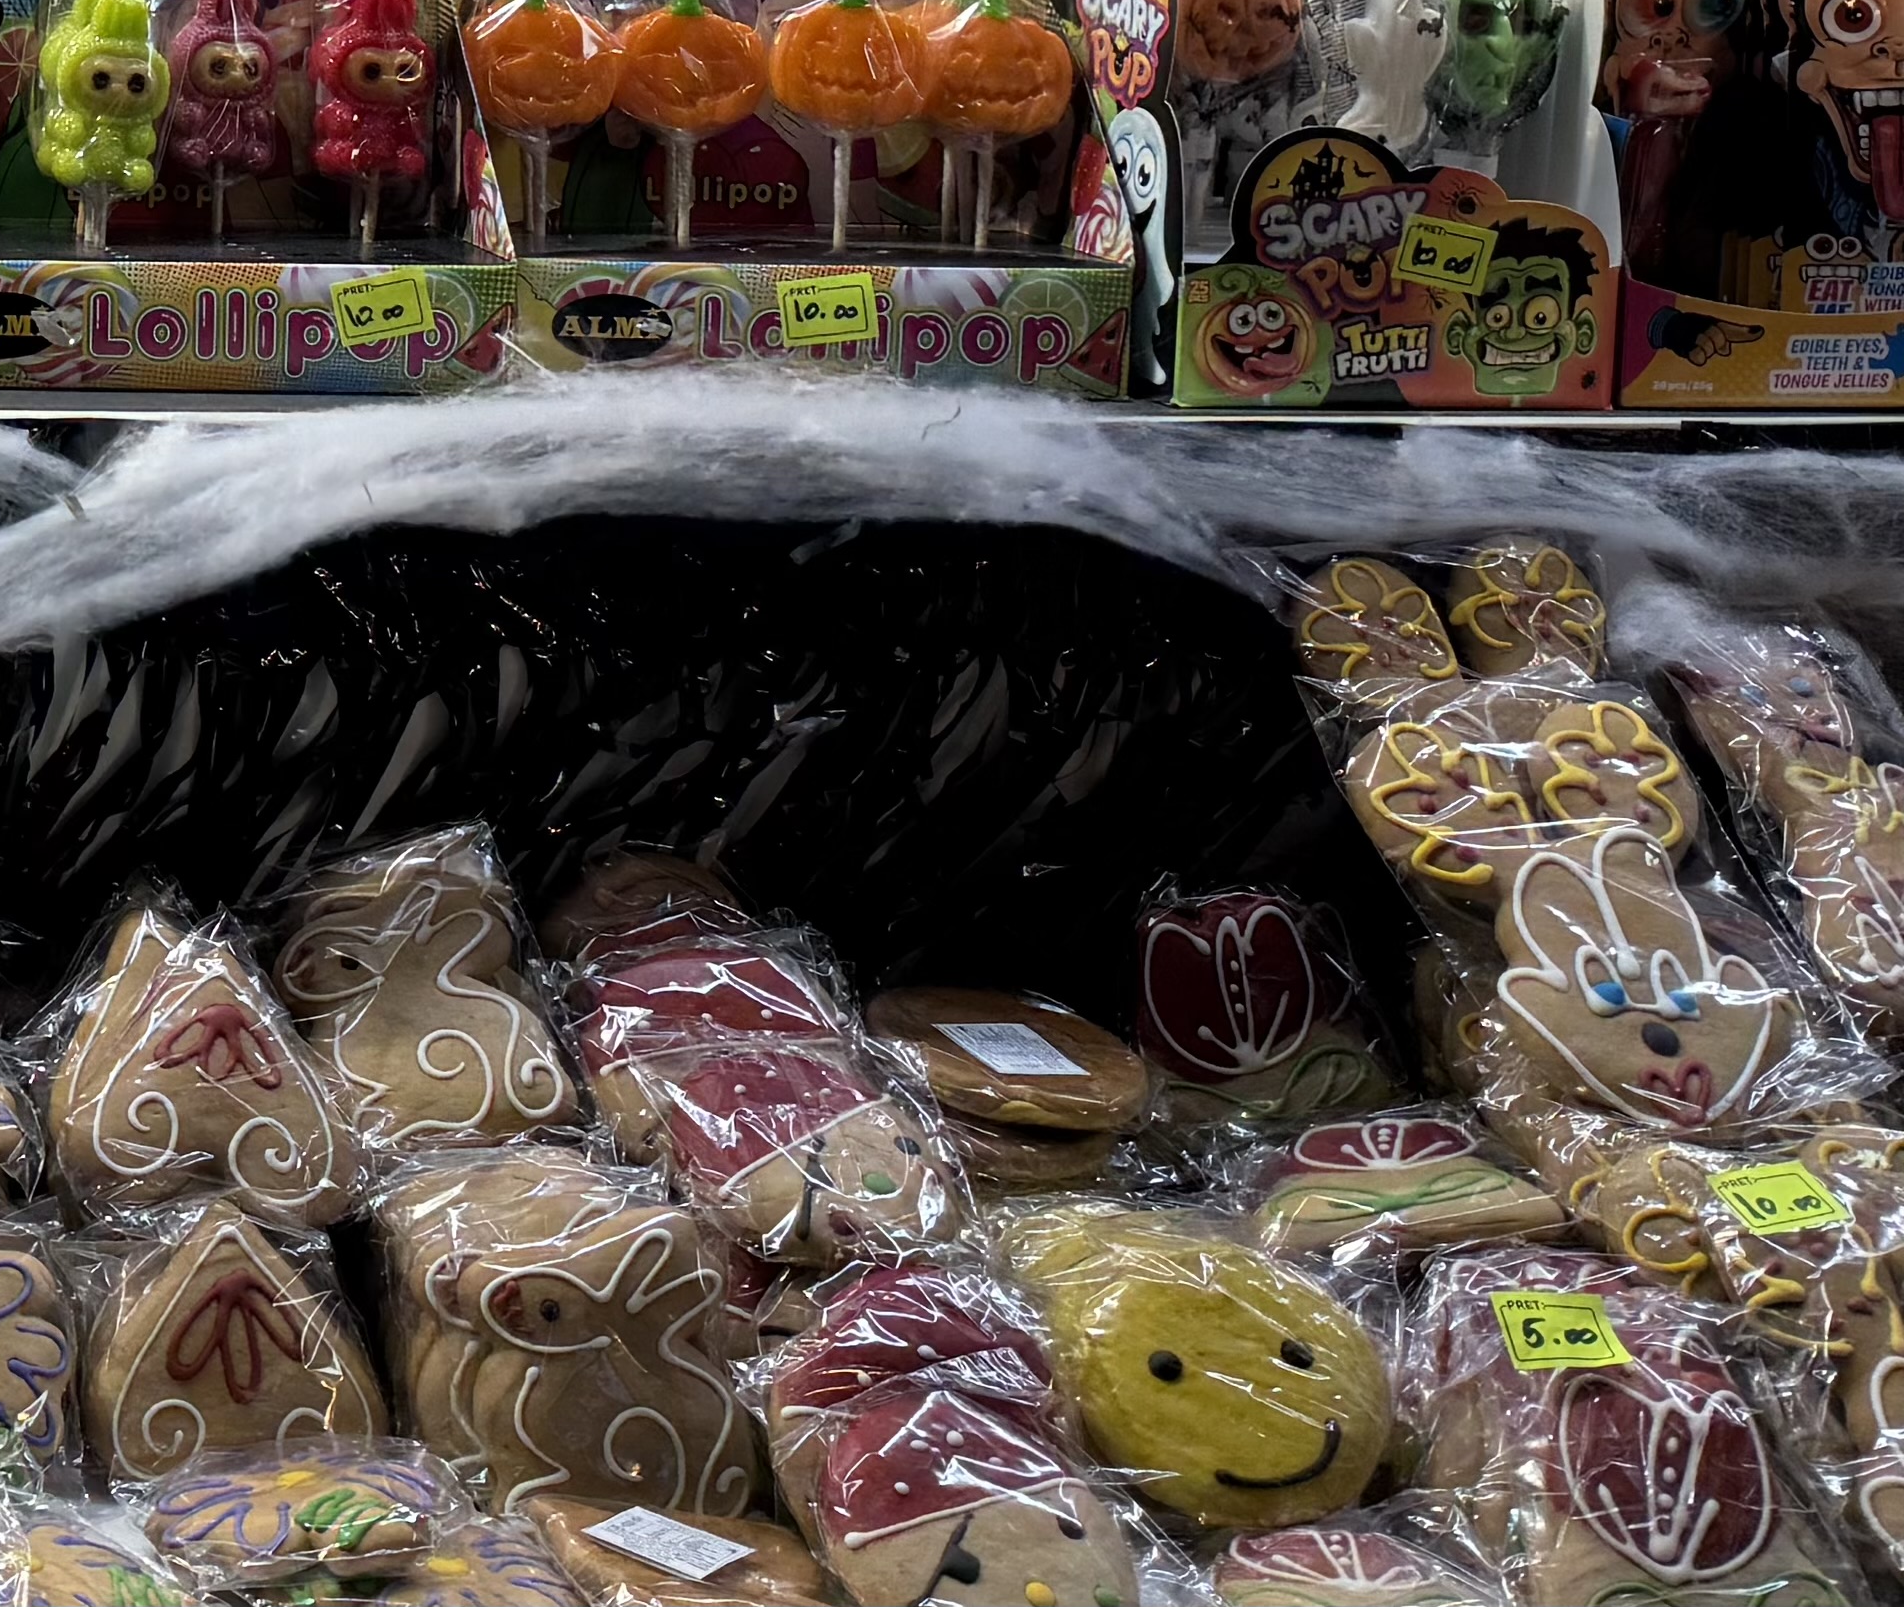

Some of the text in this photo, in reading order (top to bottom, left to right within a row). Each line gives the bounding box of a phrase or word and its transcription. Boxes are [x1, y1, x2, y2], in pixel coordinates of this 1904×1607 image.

[1091, 29, 1153, 96] PUP
[646, 177, 797, 209] Lllipop
[1259, 190, 1427, 260] SCARY
[1807, 278, 1854, 302] EAT
[794, 299, 858, 322] 10.00
[698, 293, 1073, 383] Loipop
[1790, 337, 1886, 355] EDIBLE EYES,
[1806, 356, 1848, 371] TEETH
[1773, 373, 1890, 388] TONGUE JELLIES
[1507, 1300, 1545, 1311] PRET:
